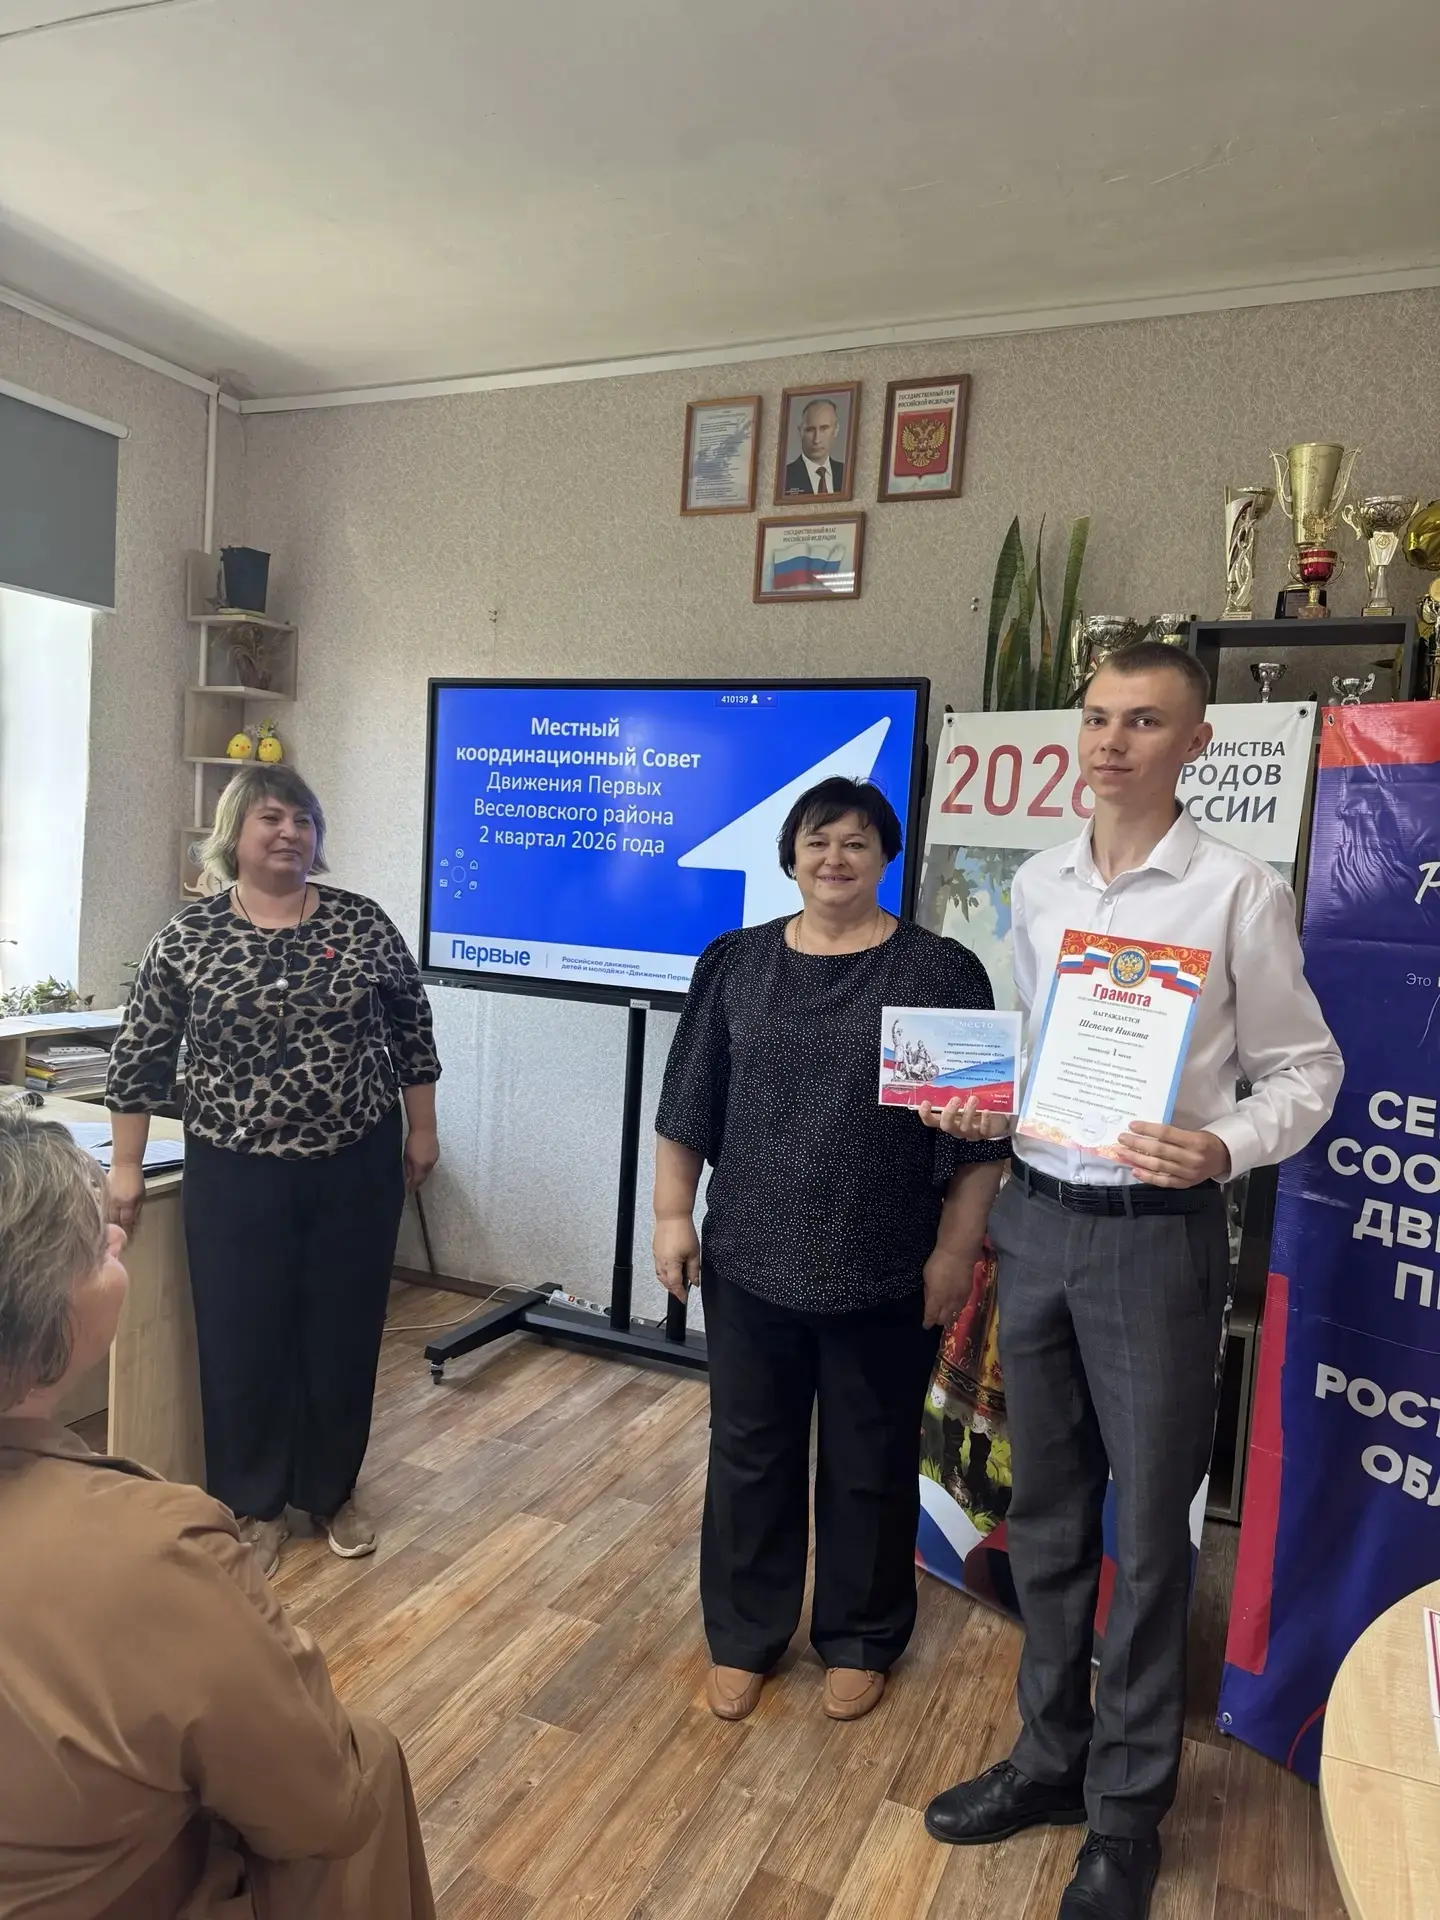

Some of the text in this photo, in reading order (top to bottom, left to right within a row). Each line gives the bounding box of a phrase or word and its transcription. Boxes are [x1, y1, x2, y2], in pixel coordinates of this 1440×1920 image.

[721, 695, 749, 704] 410139
[531, 717, 620, 738] Местный
[456, 746, 702, 769] координационный Совет
[486, 771, 662, 799] Движения Первых
[474, 798, 674, 827] Веселовского района
[479, 825, 665, 856] 2 квартал 2026 года
[452, 939, 531, 968] Первые
[562, 956, 640, 970] Российское движение
[561, 963, 582, 971] детей
[588, 966, 625, 975] молодёжи
[1405, 973, 1432, 987] Это
[1093, 983, 1152, 1007] Грамота
[1079, 1018, 1149, 1040] Шепелев Никита
[1093, 1010, 1141, 1025] НАГРАЖДАЕТСЯ
[1368, 1090, 1440, 1139] СЕ
[1327, 1137, 1440, 1194] СОО
[1352, 1198, 1440, 1254] ДВ
[1393, 1261, 1440, 1310] П
